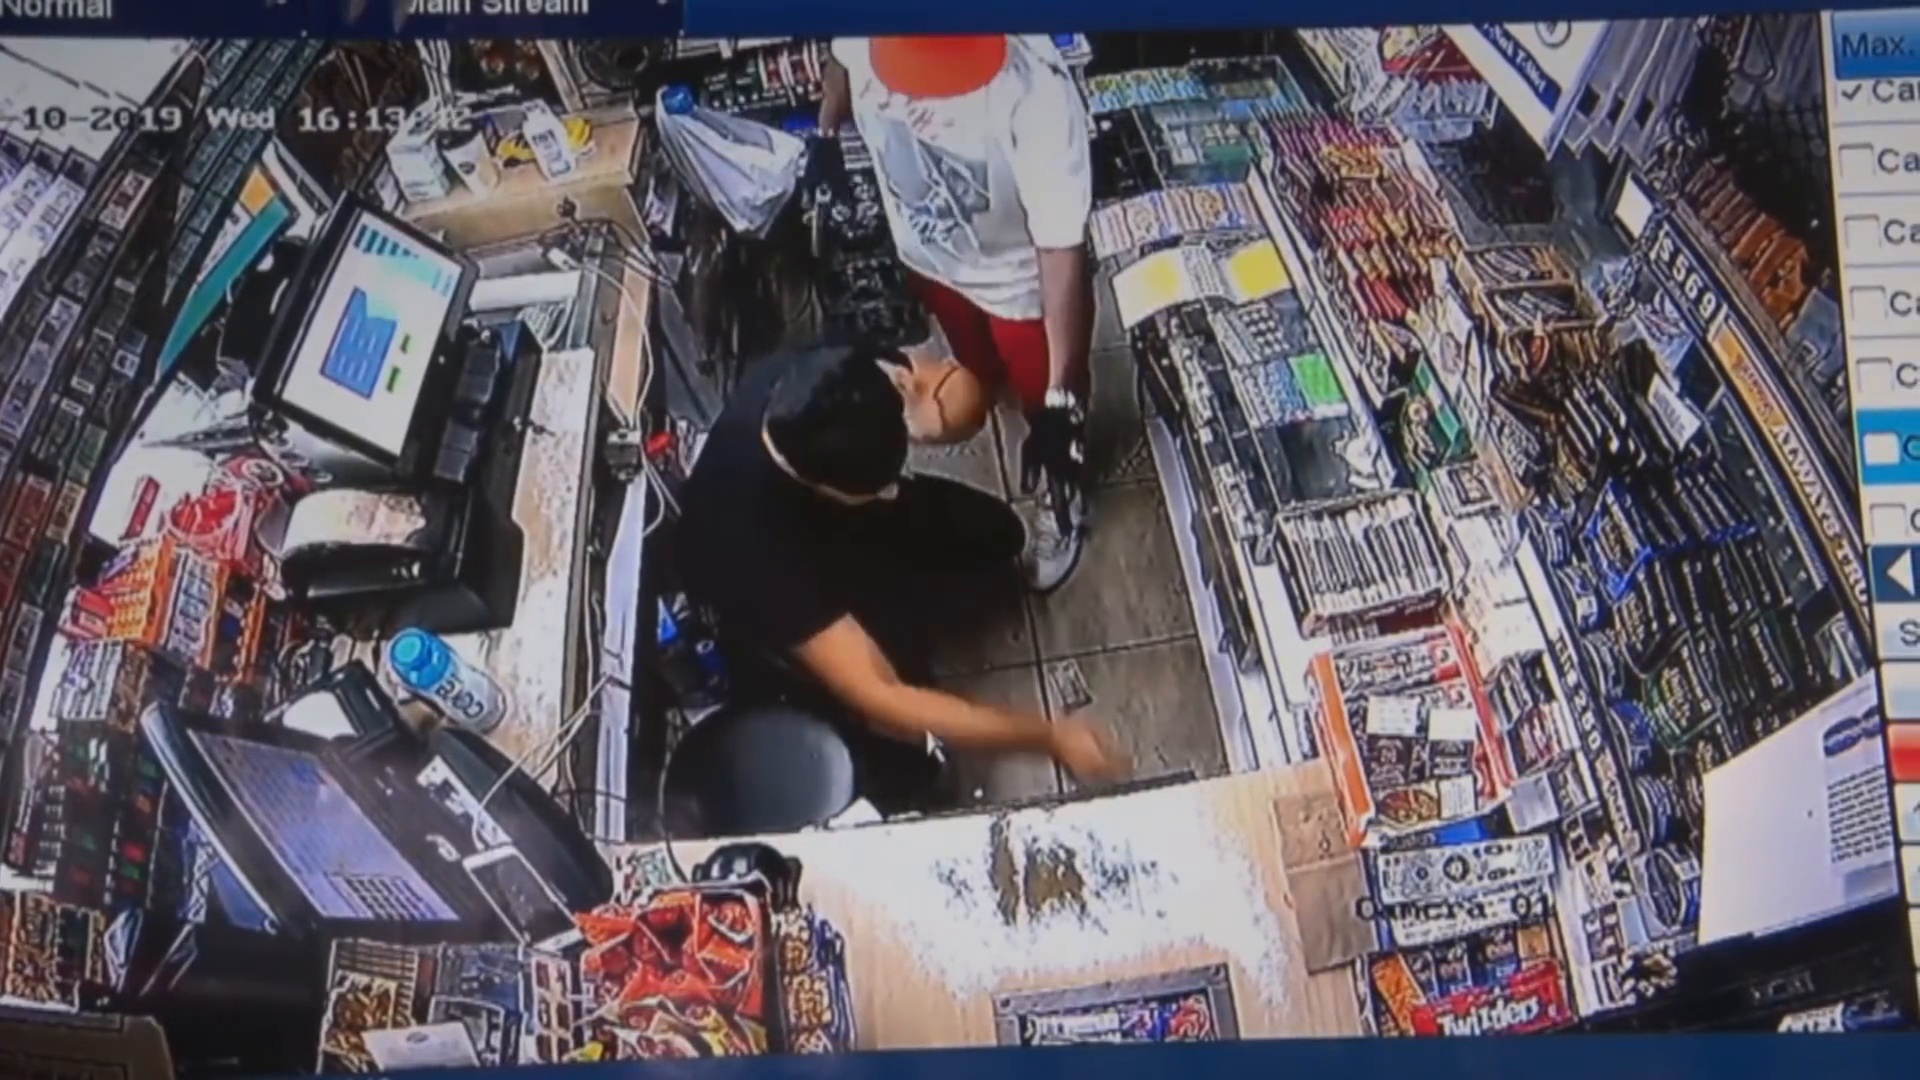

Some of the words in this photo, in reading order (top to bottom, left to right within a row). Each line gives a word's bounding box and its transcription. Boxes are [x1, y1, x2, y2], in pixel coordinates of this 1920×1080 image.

[0, 0, 112, 18] Normal
[482, 0, 588, 14] Stream
[1770, 423, 1842, 538] ALWAYS
